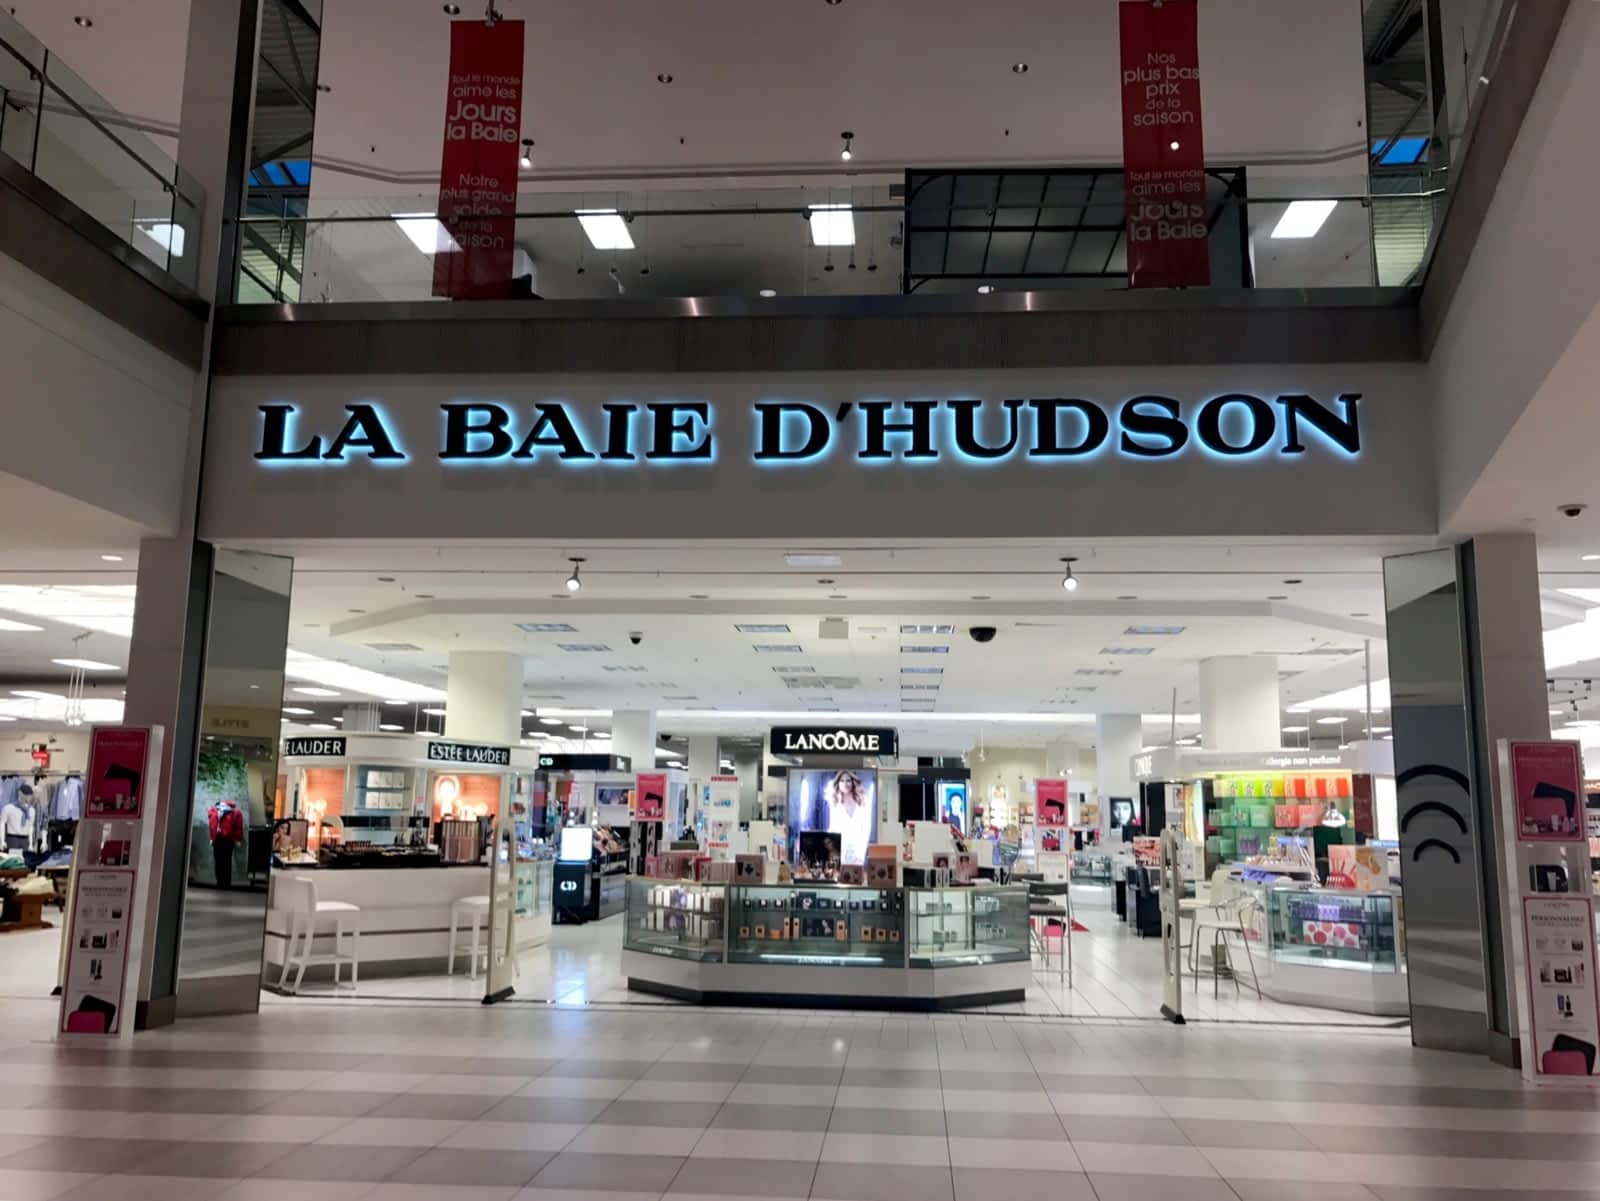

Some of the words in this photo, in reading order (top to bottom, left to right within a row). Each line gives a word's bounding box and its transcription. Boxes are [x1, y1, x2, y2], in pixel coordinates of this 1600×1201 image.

[1147, 52, 1176, 65] Nos
[1123, 67, 1161, 85] plus
[1166, 65, 1200, 81] bas
[453, 85, 492, 98] aime
[496, 85, 516, 98] les
[1145, 80, 1180, 99] prix
[1146, 98, 1164, 109] de
[1168, 97, 1181, 108] la
[449, 100, 517, 124] Jours
[1133, 109, 1194, 127] saison
[447, 123, 466, 141] la
[471, 122, 518, 143] Baie
[459, 174, 498, 188] Notre
[1132, 181, 1175, 196] aime
[1179, 179, 1201, 194] les
[441, 187, 470, 202] plus
[1130, 222, 1151, 242] la
[1158, 219, 1208, 241] Baie
[453, 234, 504, 249] aison
[253, 404, 406, 460] LA
[438, 401, 713, 460] BAIE
[753, 392, 1363, 461] D'HUDSON
[291, 740, 342, 755] LAUDER
[466, 747, 508, 764] LAUDER
